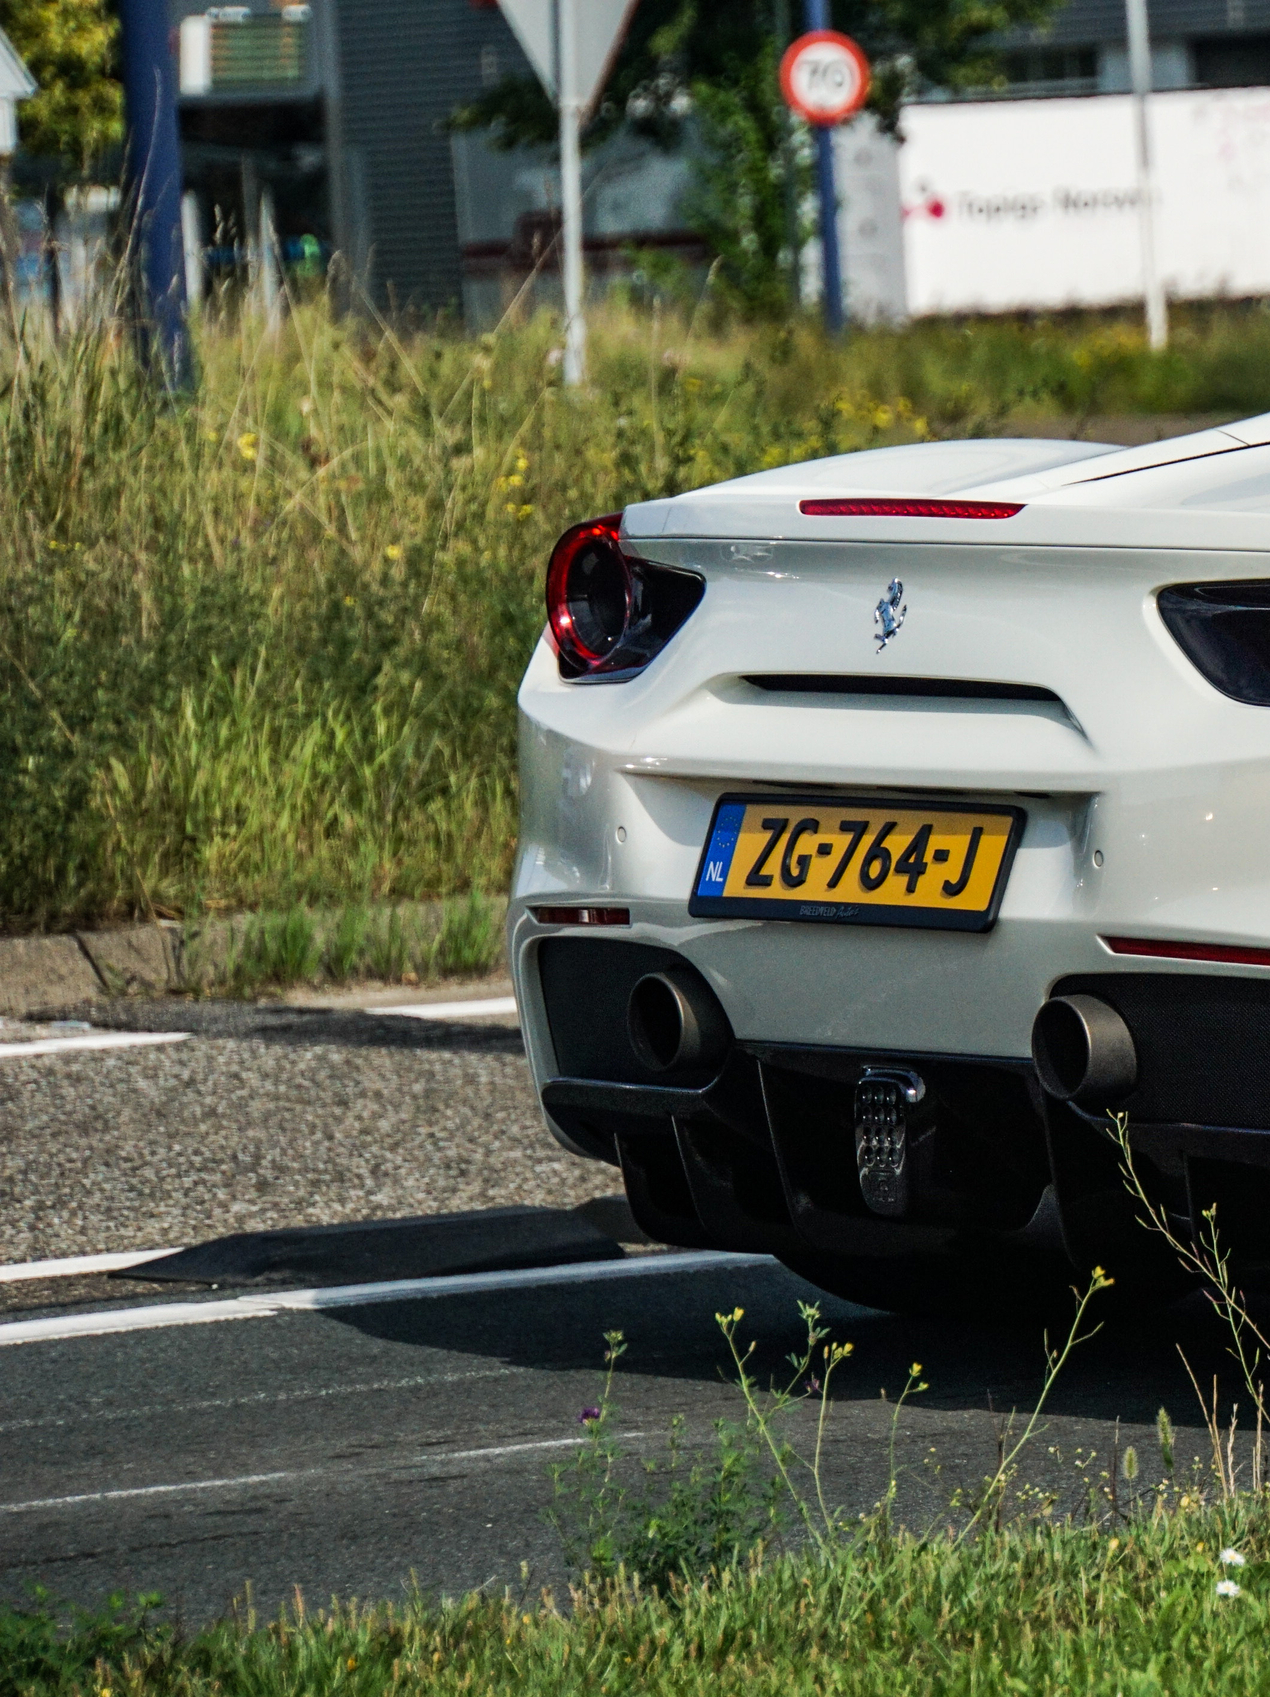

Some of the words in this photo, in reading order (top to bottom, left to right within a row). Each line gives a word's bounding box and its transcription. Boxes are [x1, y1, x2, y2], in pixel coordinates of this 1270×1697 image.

[797, 58, 853, 96] 70
[705, 861, 724, 882] NL
[745, 817, 984, 898] ZG-764-J
